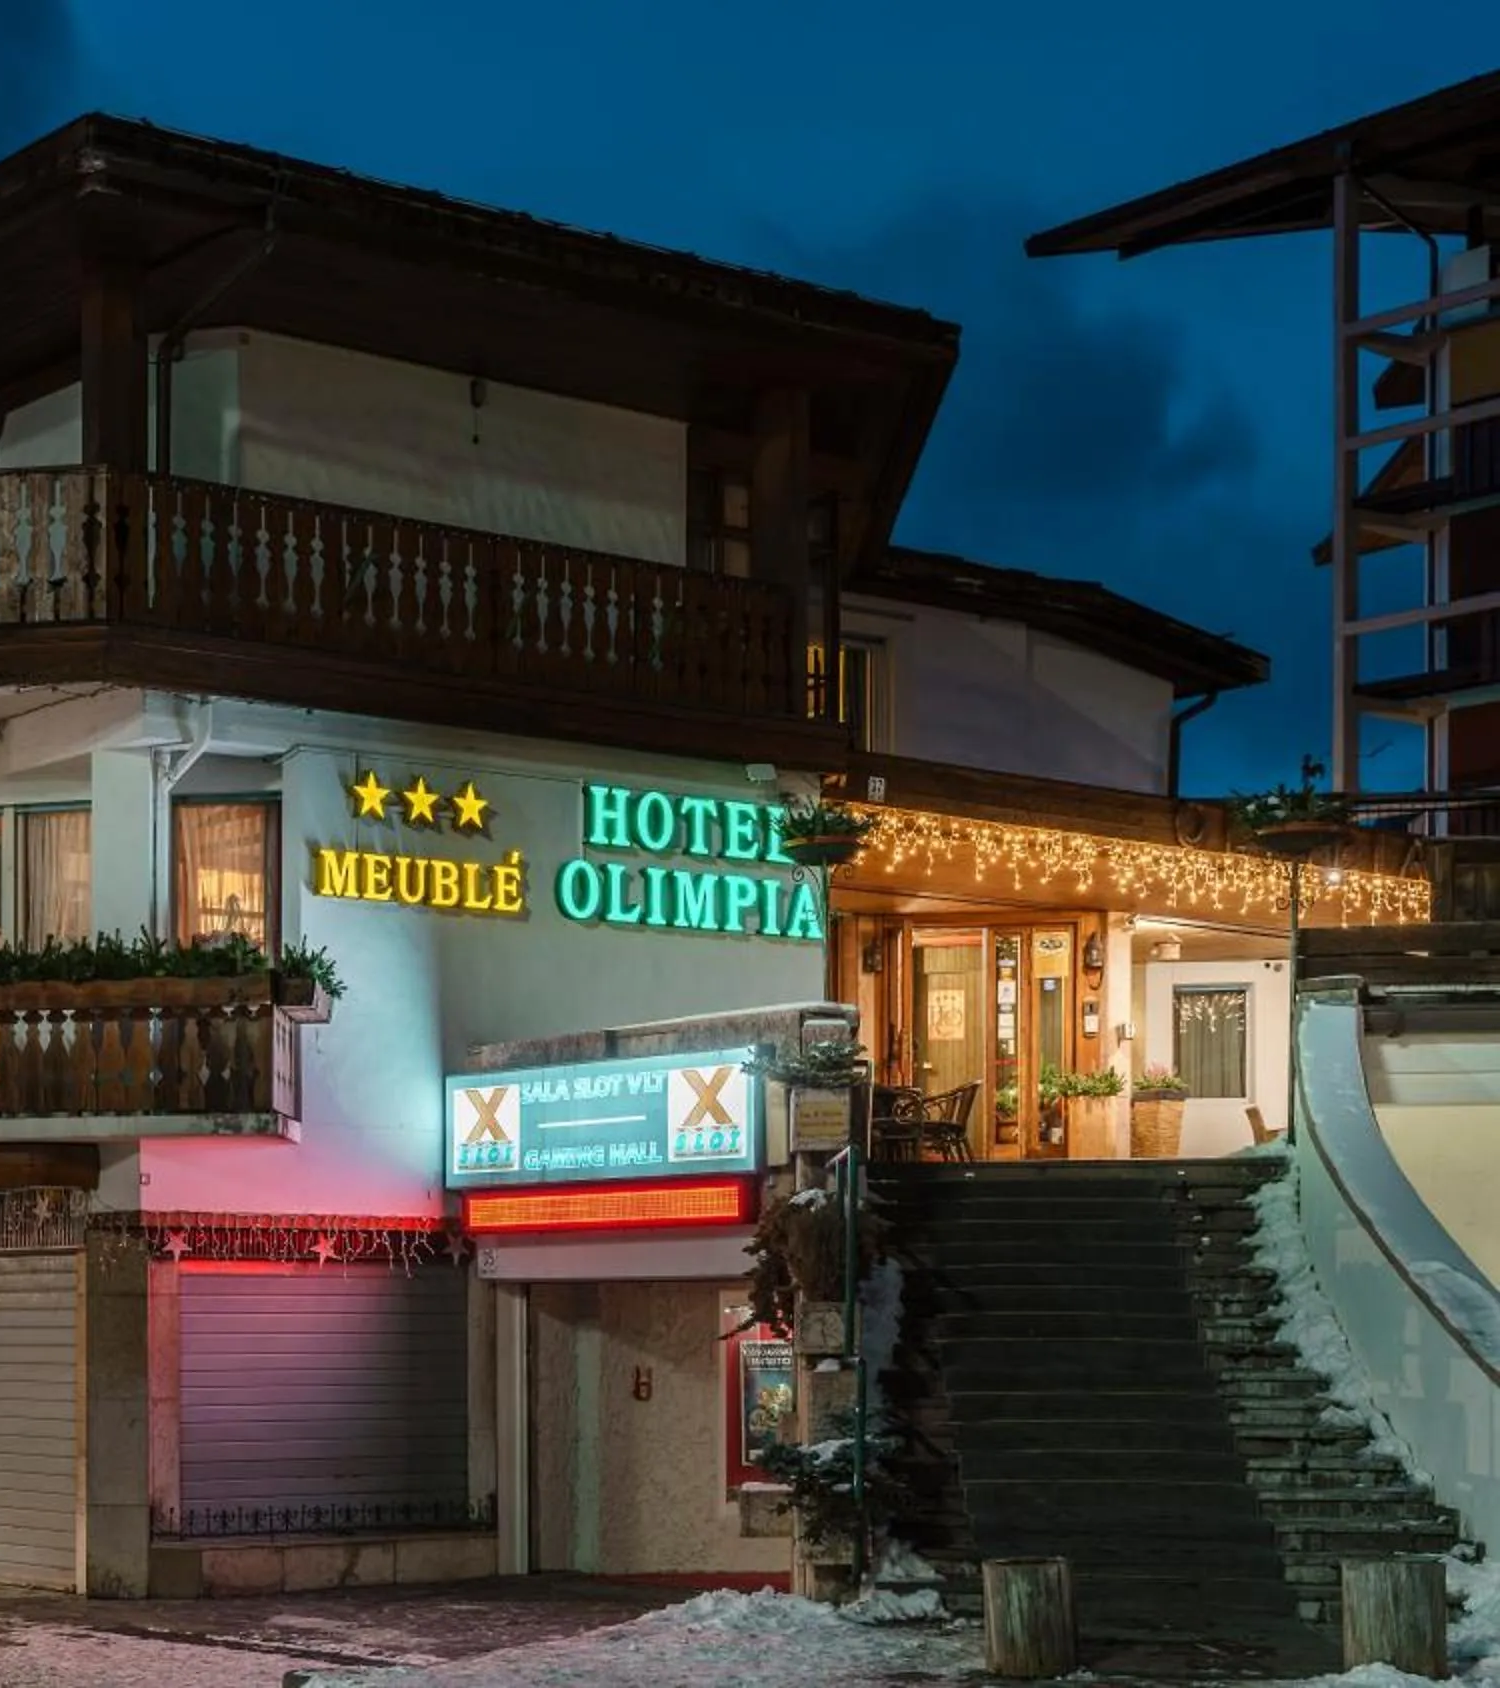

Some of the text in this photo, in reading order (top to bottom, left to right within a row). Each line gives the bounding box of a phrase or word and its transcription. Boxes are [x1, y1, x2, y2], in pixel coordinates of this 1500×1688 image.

[589, 784, 795, 864] HOTEL
[319, 848, 523, 912] MEUBLÉ
[558, 858, 825, 939] OLIMPIA
[522, 1071, 668, 1104] SALA SLOT VLT
[524, 1141, 663, 1171] GAMING HALL
